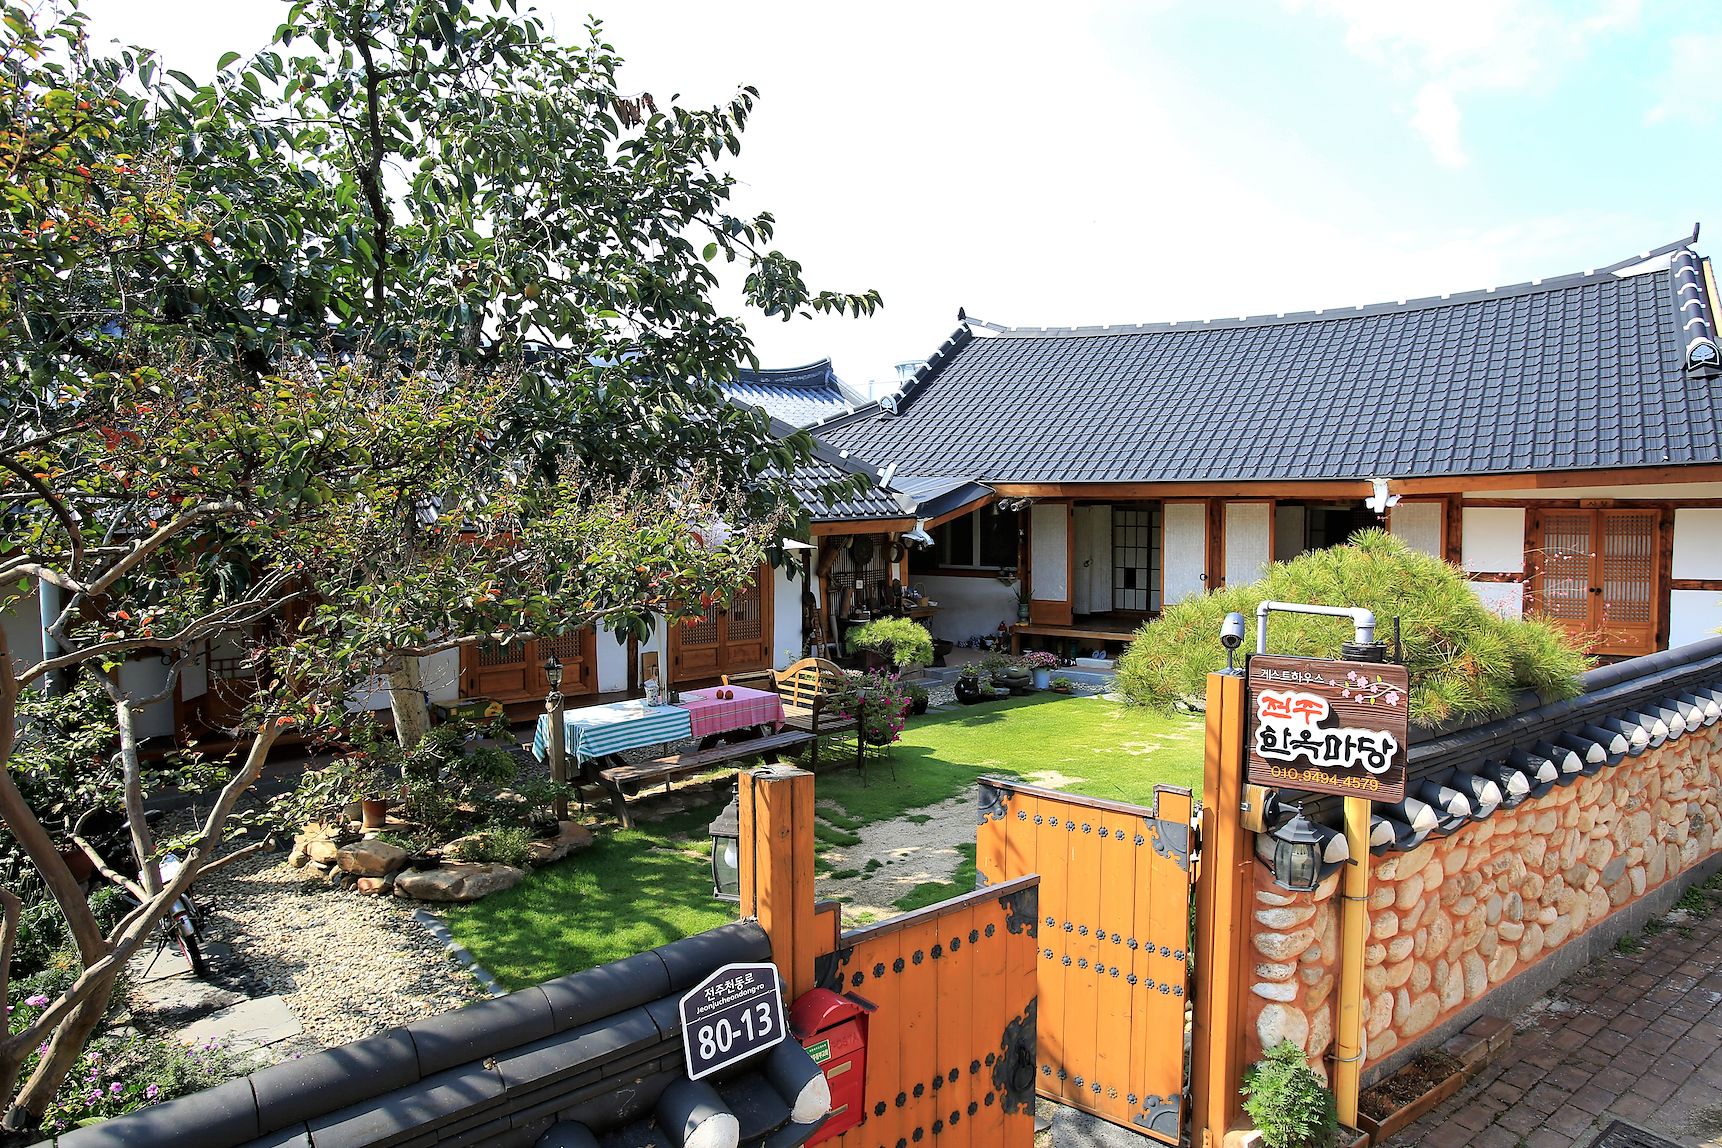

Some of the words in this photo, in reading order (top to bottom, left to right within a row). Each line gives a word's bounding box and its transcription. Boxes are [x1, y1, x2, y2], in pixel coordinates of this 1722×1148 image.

[1260, 668, 1325, 684] 게스트하우스
[1261, 696, 1324, 725] 전주
[1260, 725, 1394, 769] 한옥마당
[1271, 766, 1379, 791] 010.9494.4579
[696, 983, 765, 1015] Jeonjucheondong-ro
[704, 972, 755, 1002] 전주천동로
[697, 1002, 774, 1060] 80-13
